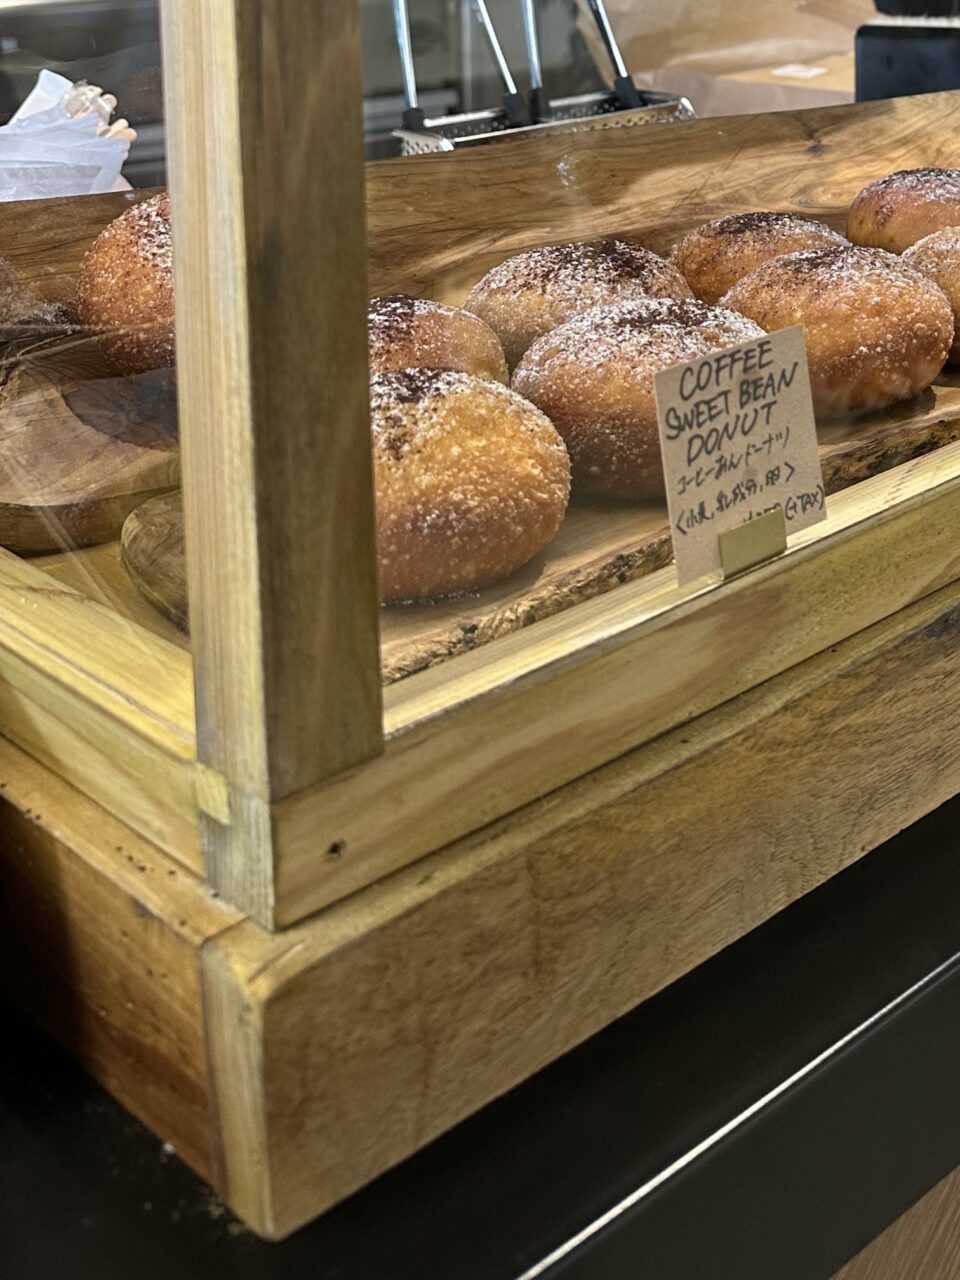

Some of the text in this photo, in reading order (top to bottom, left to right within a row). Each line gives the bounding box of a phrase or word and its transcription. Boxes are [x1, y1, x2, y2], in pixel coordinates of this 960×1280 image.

[665, 361, 799, 441] SWEET BEAN
[679, 340, 773, 401] COFFEE
[686, 400, 778, 467] DONUT
